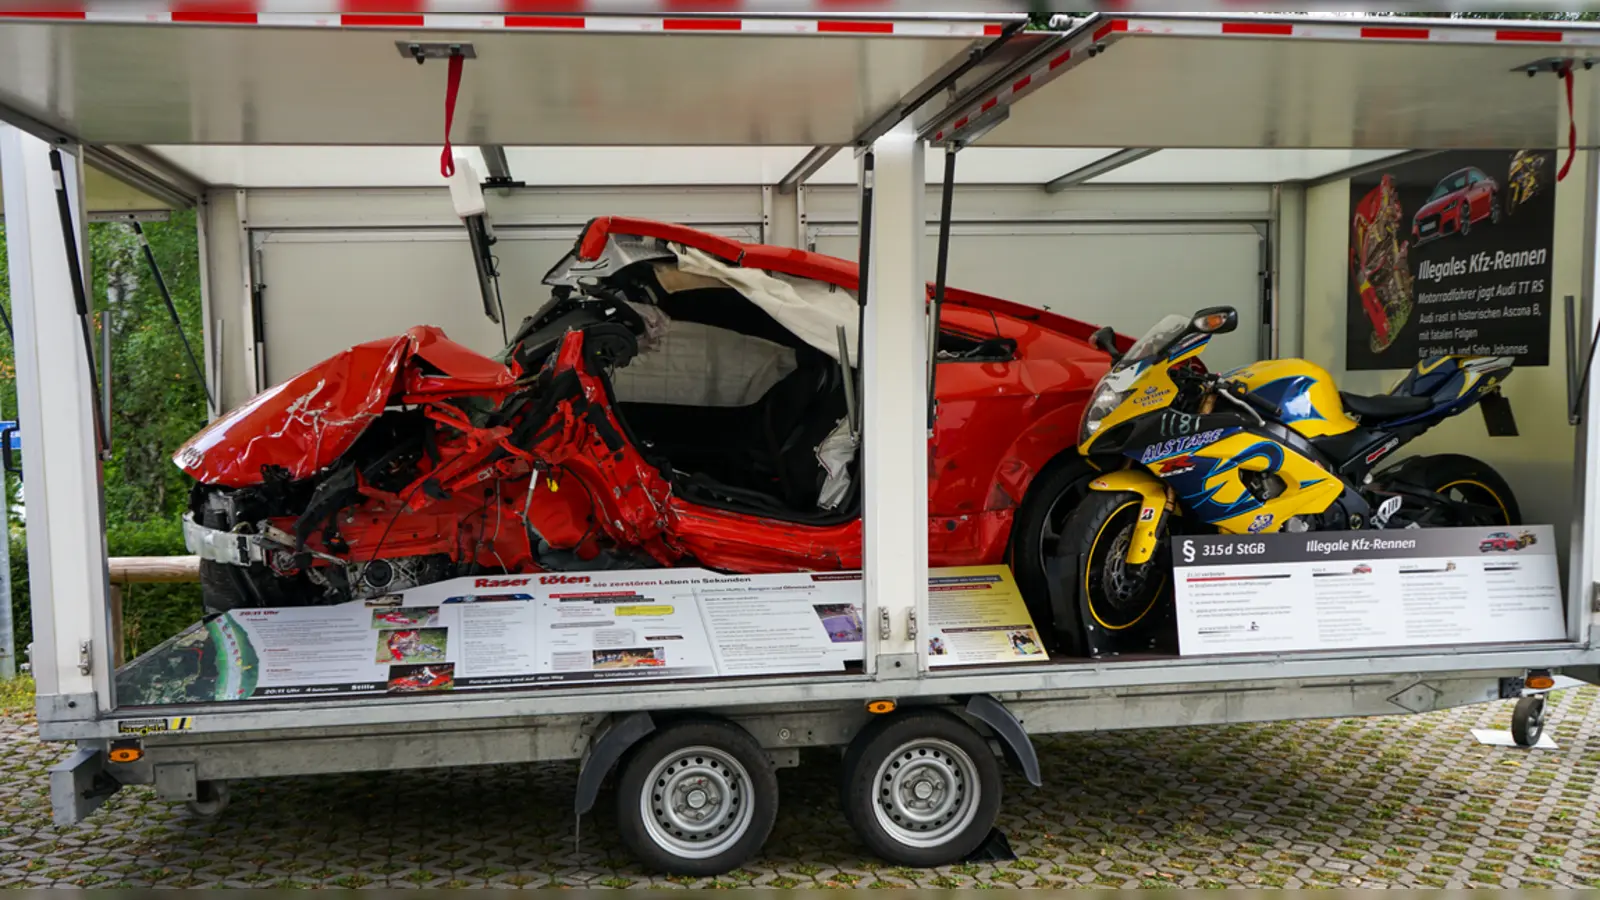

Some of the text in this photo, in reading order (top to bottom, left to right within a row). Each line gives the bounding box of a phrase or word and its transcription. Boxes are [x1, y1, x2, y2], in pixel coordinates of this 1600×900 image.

[1418, 248, 1547, 283] Illegales Kfz-Rennen
[1418, 279, 1544, 304] Motorradfahrer jagt Audi TT RS
[1419, 311, 1433, 324] Audi
[1435, 311, 1449, 322] rast
[1450, 310, 1457, 320] in
[1458, 307, 1501, 321] historischen
[1503, 305, 1531, 318] Ascona
[1419, 327, 1478, 341] mit fatalen Folgen
[1472, 344, 1491, 355] Sohn
[1492, 343, 1528, 355] Johannes
[1236, 542, 1266, 555] StGB
[1306, 539, 1349, 555] Illegale
[1351, 538, 1416, 551] Kfz-Rennen
[475, 577, 531, 588] Raser
[539, 574, 591, 585] töten
[609, 580, 657, 588] zerstören
